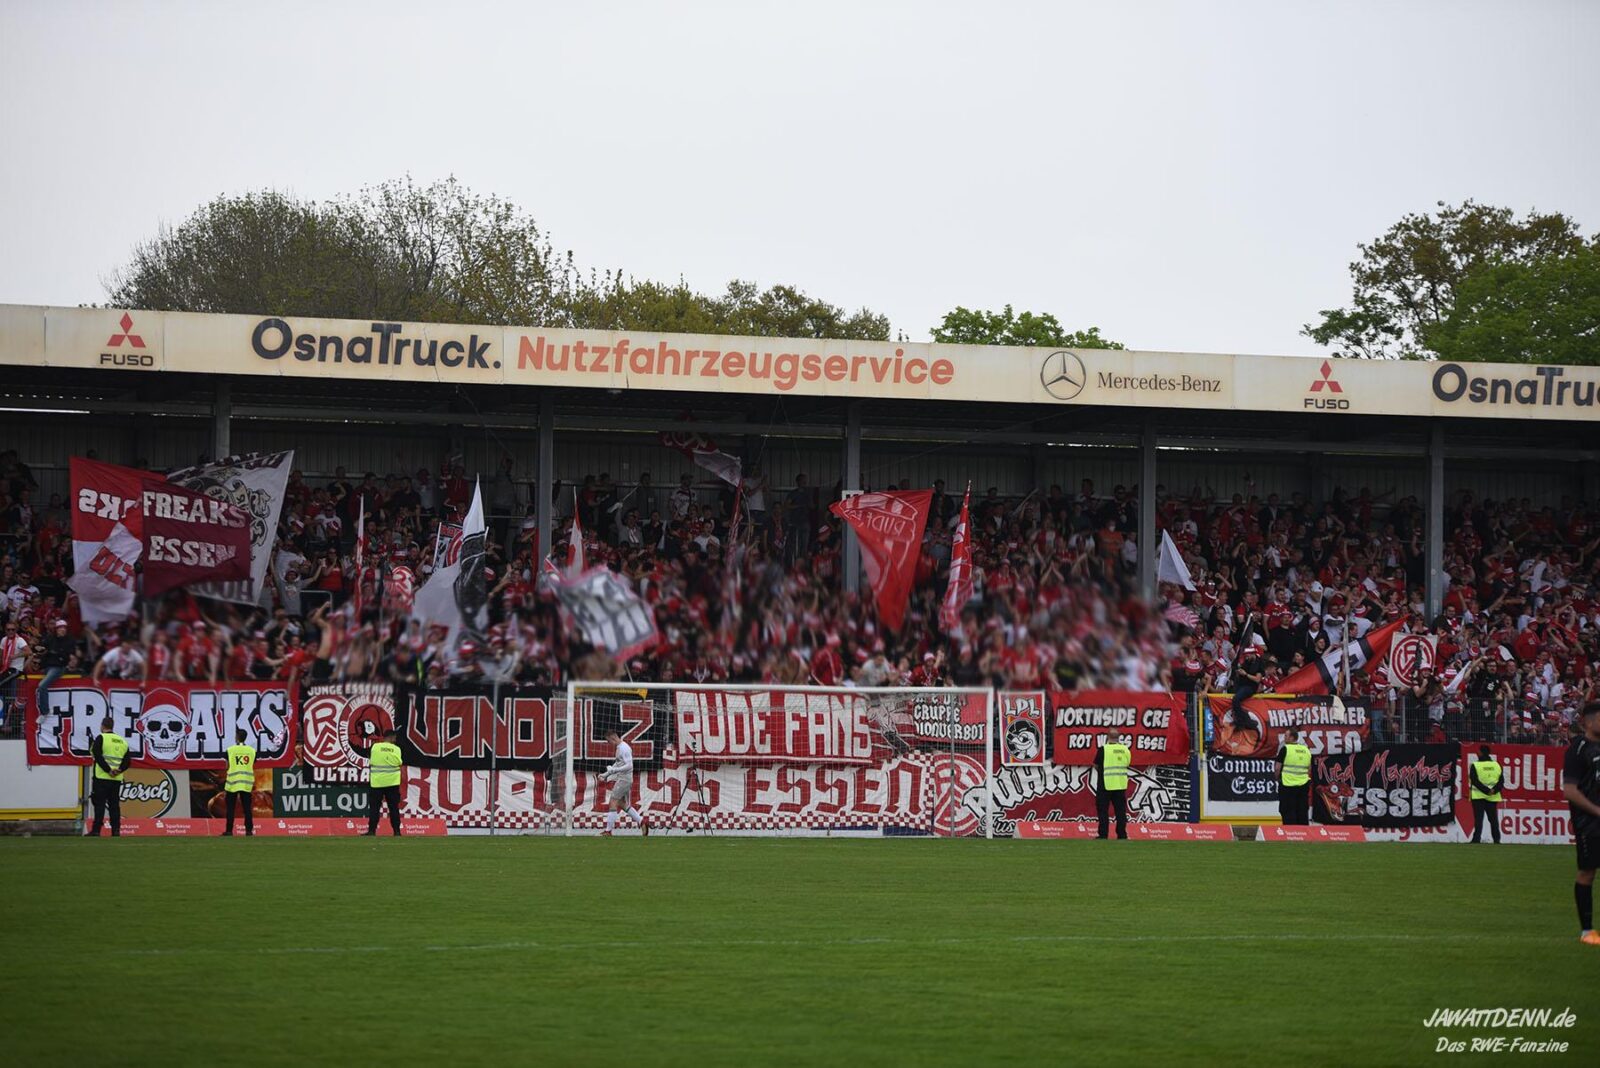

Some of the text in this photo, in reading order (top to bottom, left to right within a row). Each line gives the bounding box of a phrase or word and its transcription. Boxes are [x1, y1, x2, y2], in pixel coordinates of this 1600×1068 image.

[101, 353, 154, 366] FUSO
[251, 317, 955, 392] OsnaTruck. Nutzfahrzeugservice
[1098, 371, 1221, 393] Mercedes-Benz
[1432, 363, 1600, 407] OsnaTru
[1304, 397, 1350, 410] FUSO
[143, 491, 246, 528] FREAKS
[149, 535, 237, 568] ESSEN
[307, 685, 342, 696] JUNGE
[914, 704, 960, 722] GRUPPE
[1004, 698, 1041, 717] LPL
[1055, 707, 1137, 727] NORTHSIDE
[38, 688, 290, 758] FREAKS
[676, 691, 872, 758] RUDE FANS
[1069, 733, 1167, 751] ROT WSS ESSE
[1278, 730, 1362, 755] SSEN
[235, 755, 250, 766] K9
[282, 793, 370, 812] WILL QU
[1346, 786, 1451, 817] ESSEN
